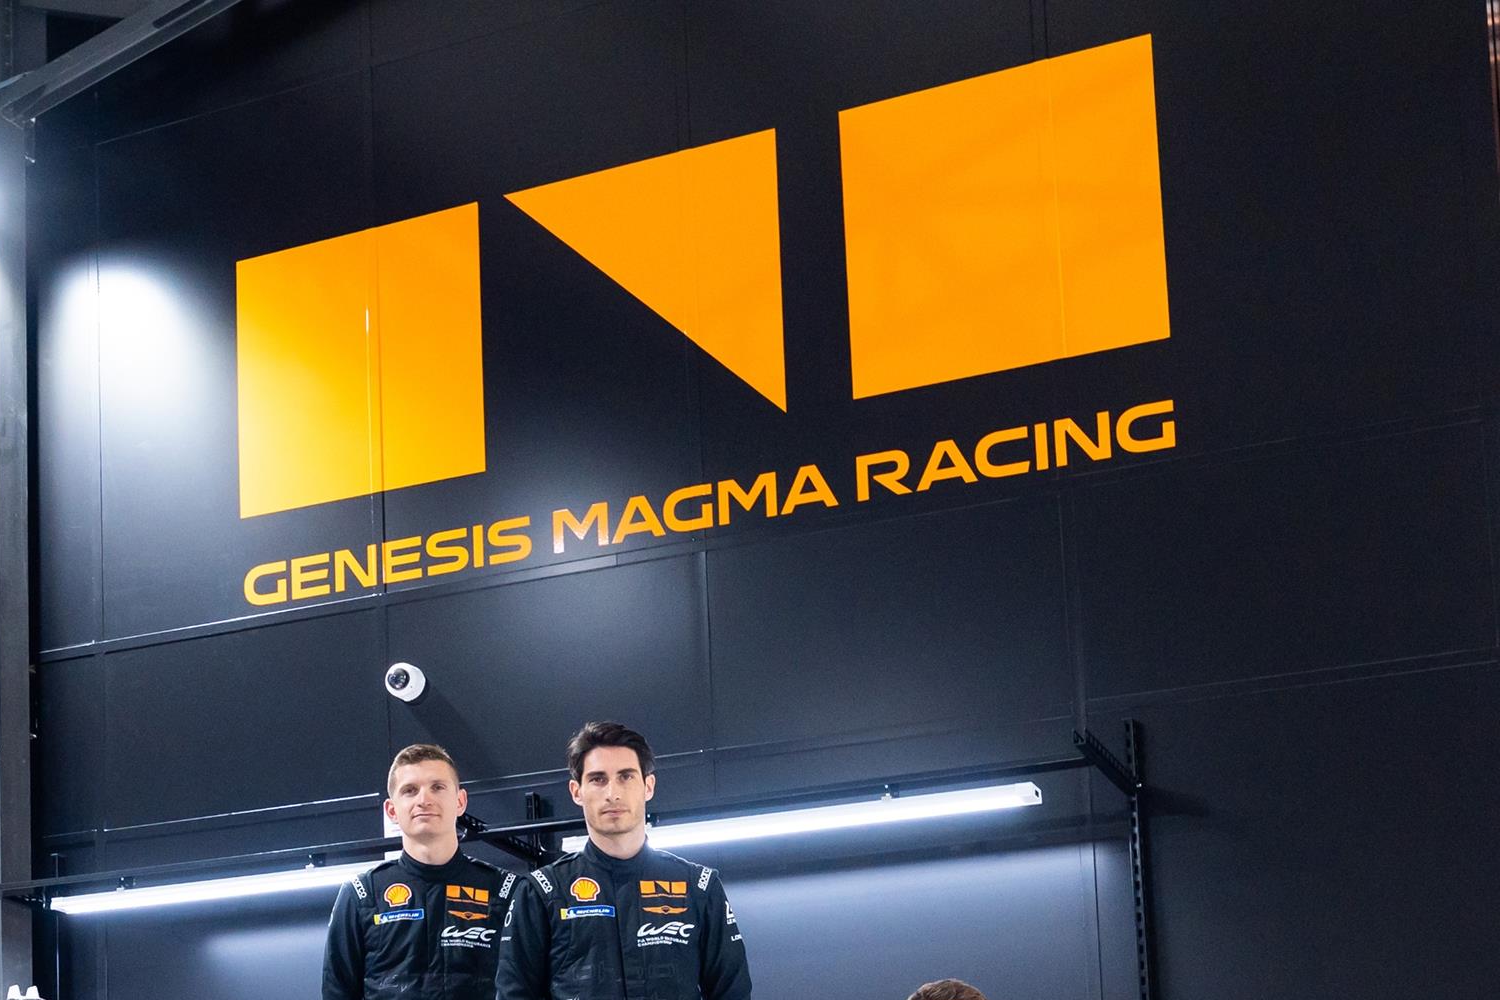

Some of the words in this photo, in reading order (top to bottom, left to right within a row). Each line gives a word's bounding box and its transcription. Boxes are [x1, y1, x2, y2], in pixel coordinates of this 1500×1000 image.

[244, 516, 531, 606] GENESIS
[553, 463, 839, 554] MAGMA
[855, 399, 1177, 501] RACING
[441, 925, 497, 941] WEC
[637, 921, 695, 938] WEC
